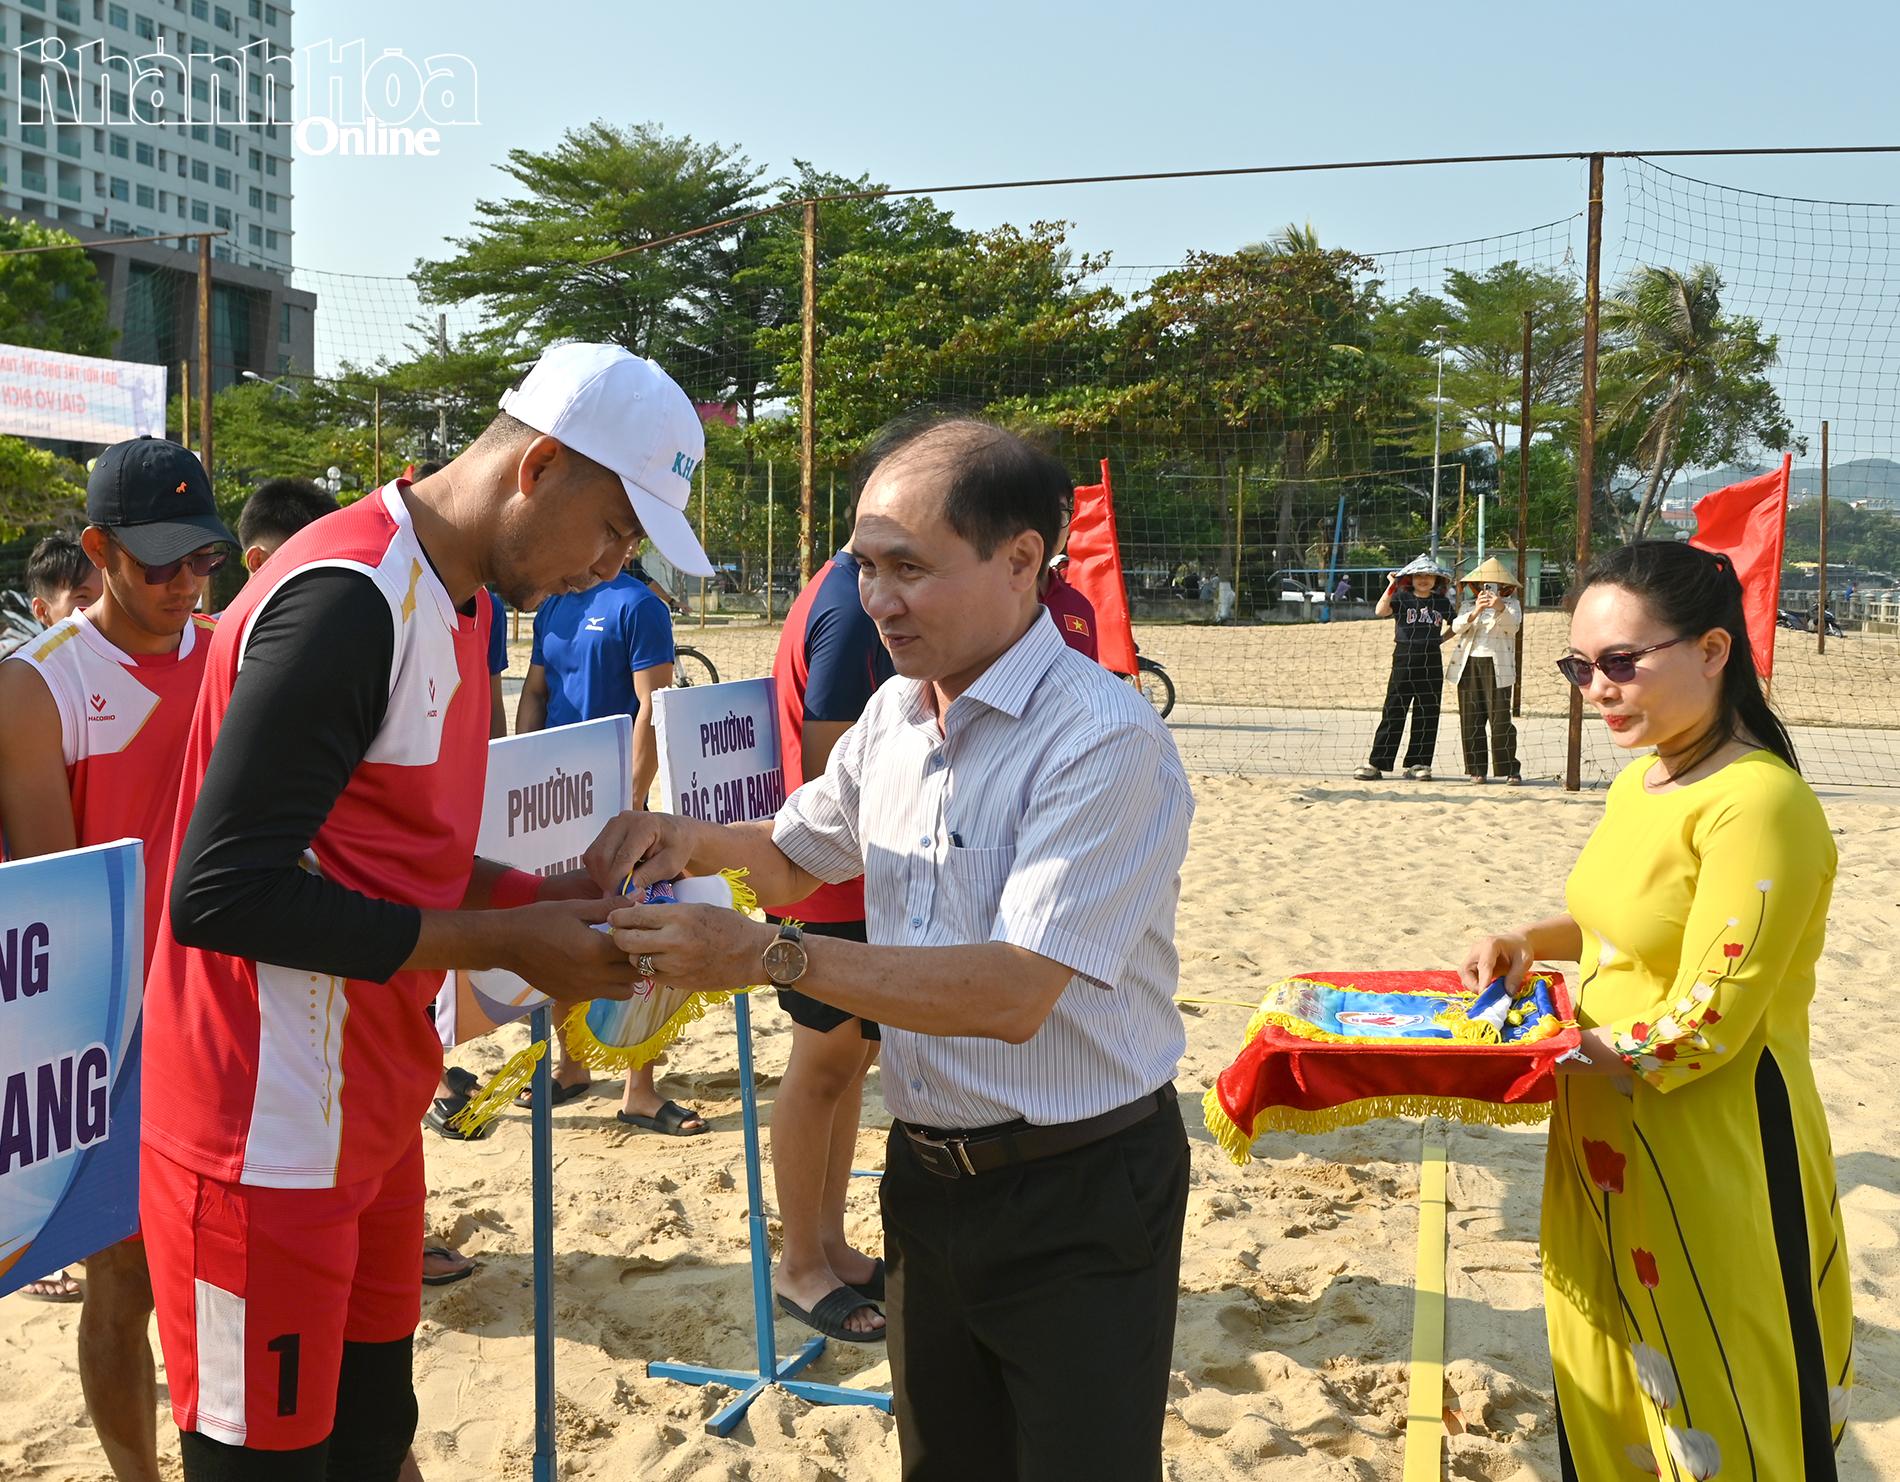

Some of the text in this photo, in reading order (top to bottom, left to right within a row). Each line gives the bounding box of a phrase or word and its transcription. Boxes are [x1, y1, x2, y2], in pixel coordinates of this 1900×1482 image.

[699, 710, 755, 758] PHƯỜNG
[508, 767, 593, 837] PHƯỜNG
[681, 769, 783, 825] BẮC CAM RANH
[0, 1047, 107, 1176] ANG
[268, 1333, 300, 1417] 1
